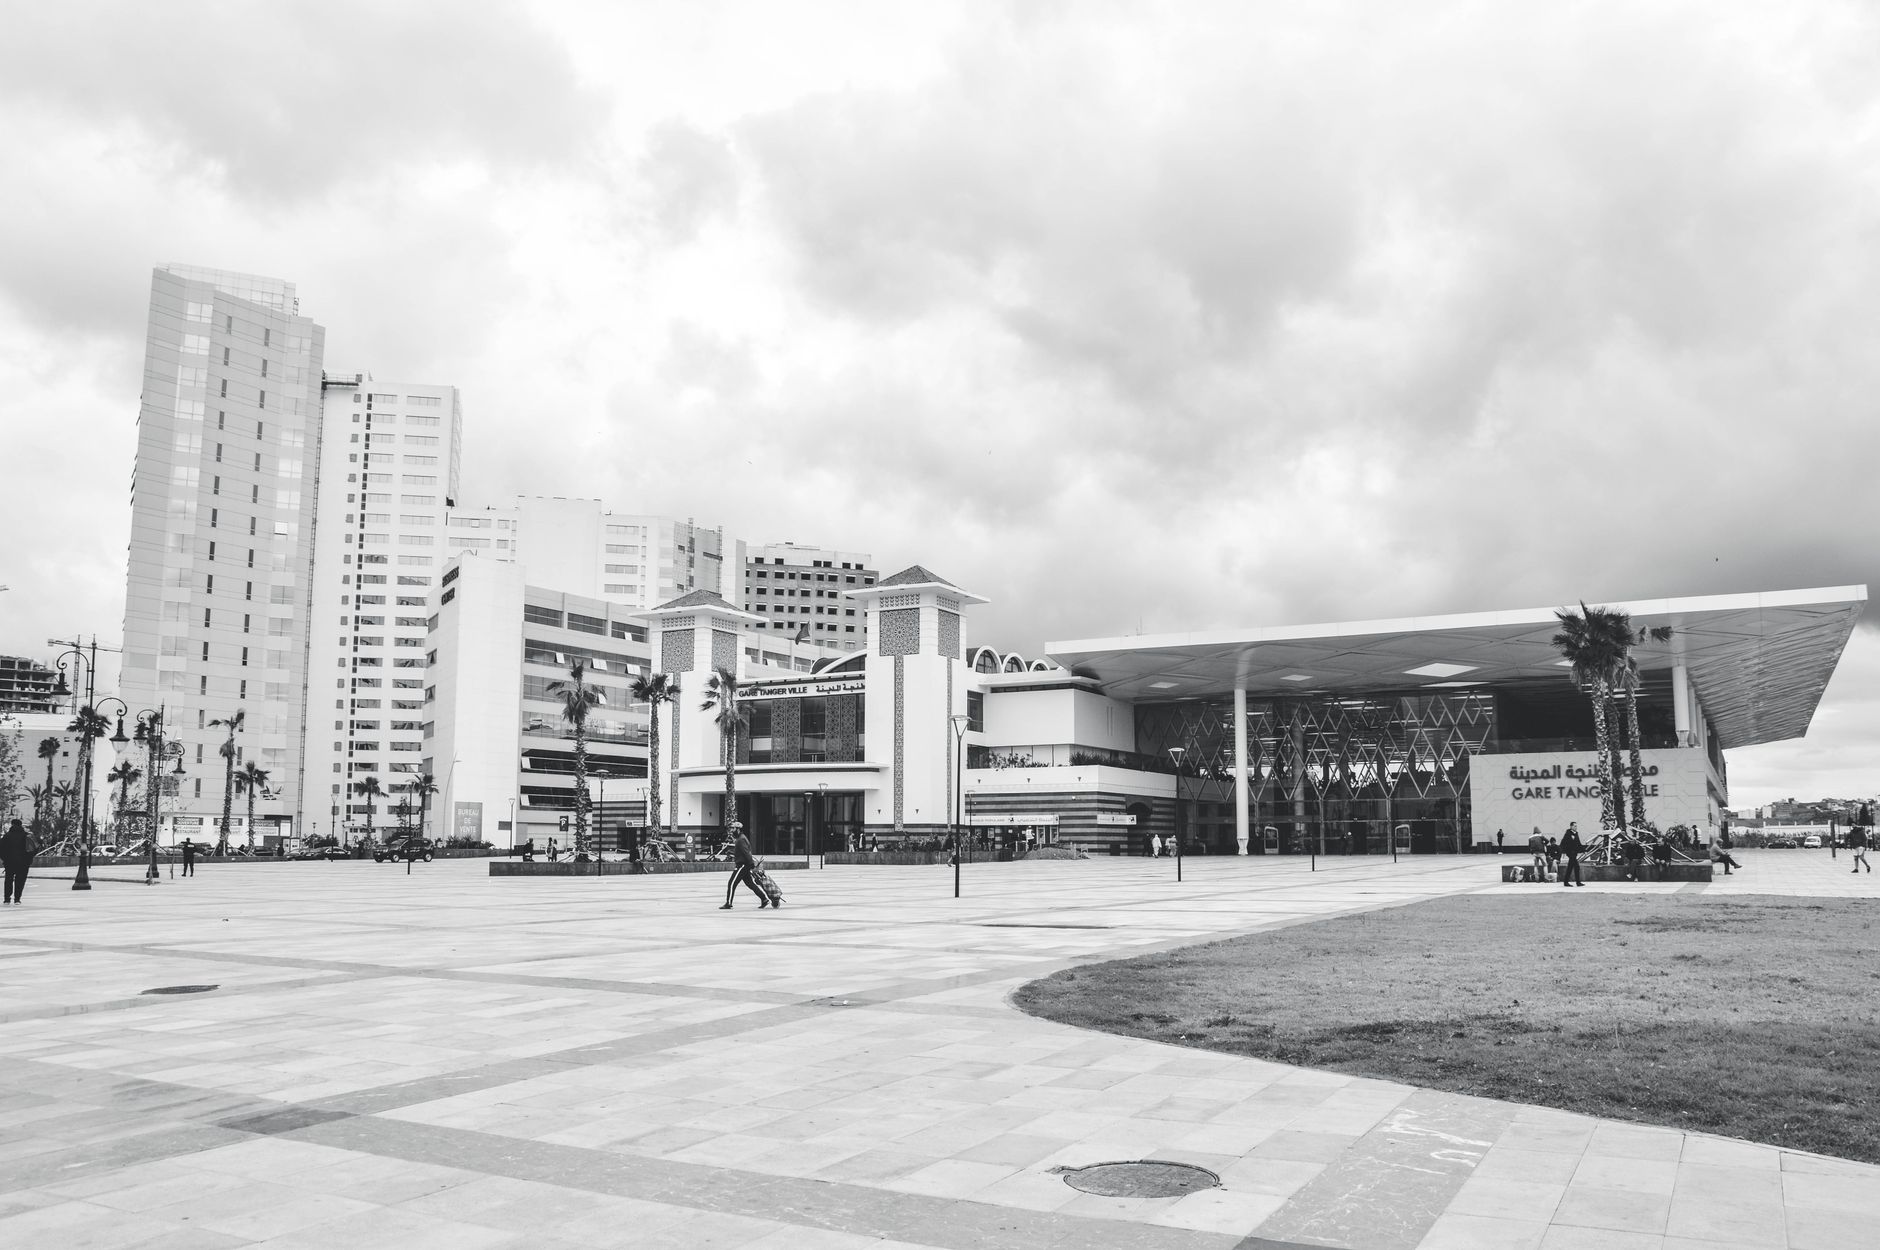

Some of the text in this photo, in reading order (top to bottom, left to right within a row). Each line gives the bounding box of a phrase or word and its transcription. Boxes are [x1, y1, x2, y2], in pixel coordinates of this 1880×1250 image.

[760, 687, 787, 696] TANGER
[788, 686, 808, 694] VILLE
[1509, 764, 1561, 783] المدينة
[1511, 784, 1659, 800] GARE TANG VLE
[457, 808, 480, 816] BUREAU
[459, 825, 477, 833] VENTE
